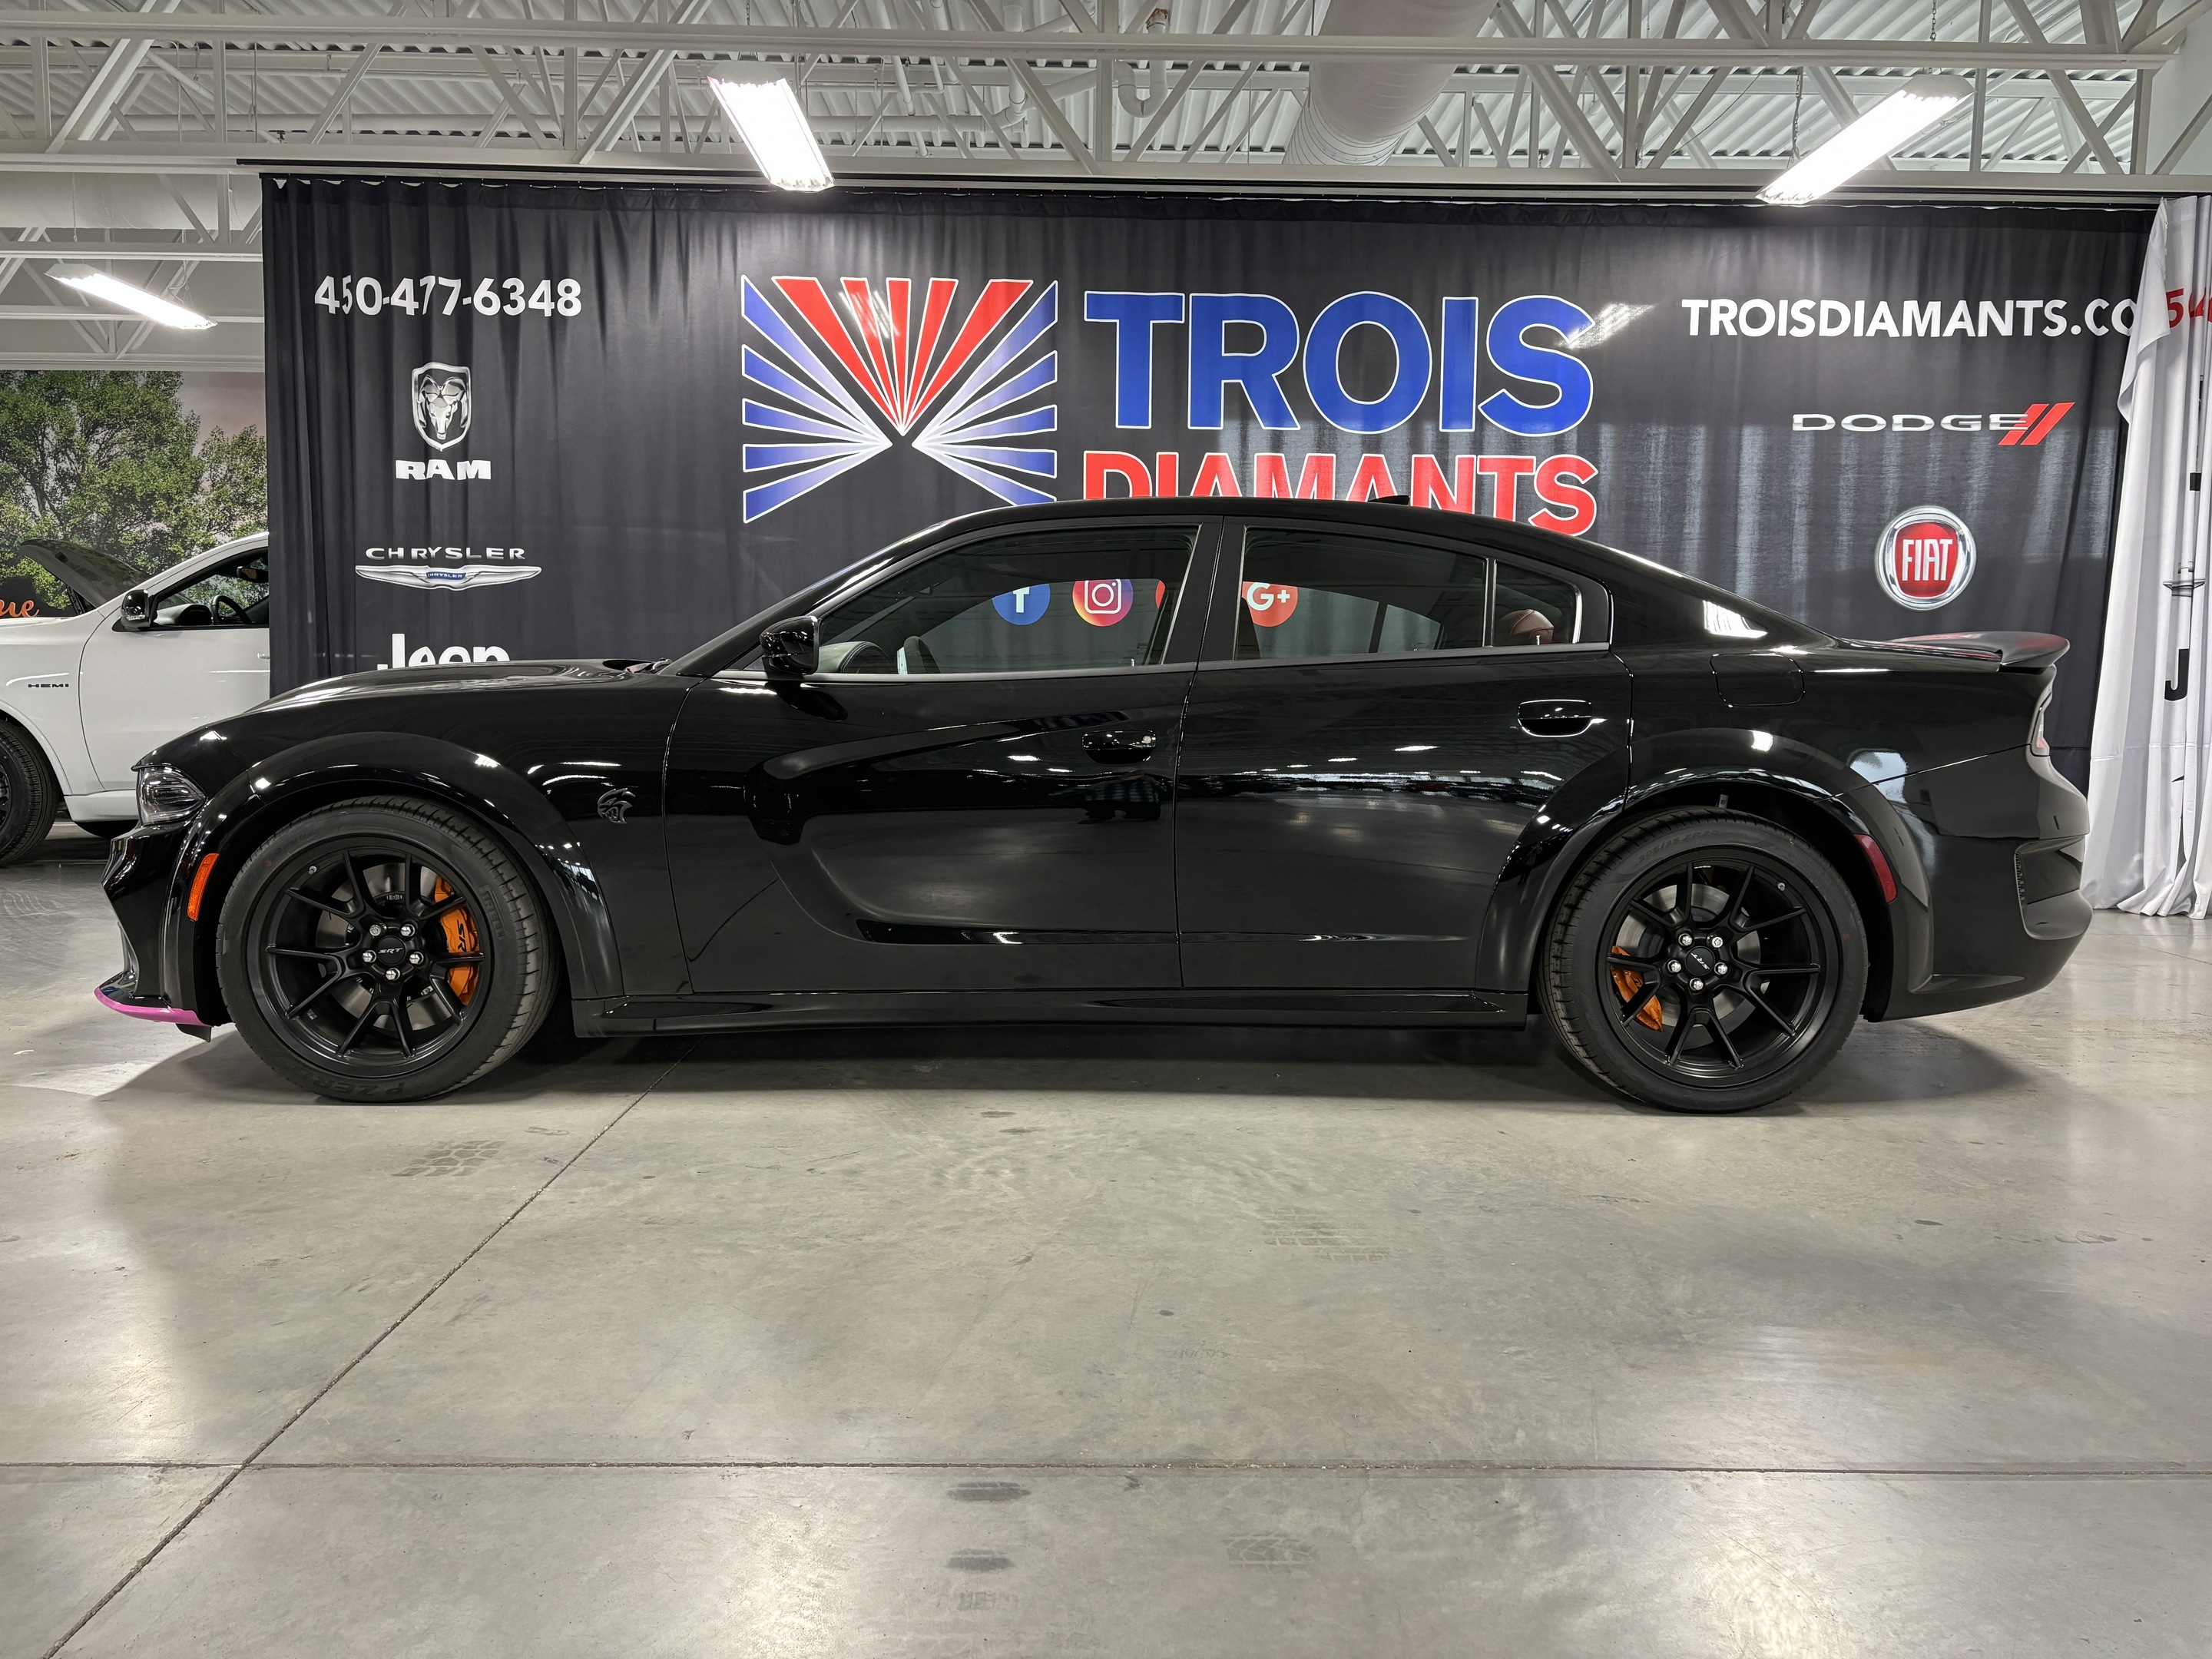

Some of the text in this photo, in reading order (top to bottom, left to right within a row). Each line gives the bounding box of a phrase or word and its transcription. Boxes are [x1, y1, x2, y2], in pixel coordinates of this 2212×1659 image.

[314, 275, 582, 317] 450-477-6348
[1084, 290, 1595, 438] TROIS
[1793, 412, 2028, 432] DODGE
[395, 459, 492, 480] RAM
[1083, 451, 1599, 538] DIAMANTS
[365, 546, 526, 560] CHRYSLER
[1902, 538, 1953, 581] FIAT
[1690, 952, 1711, 971] SRT
